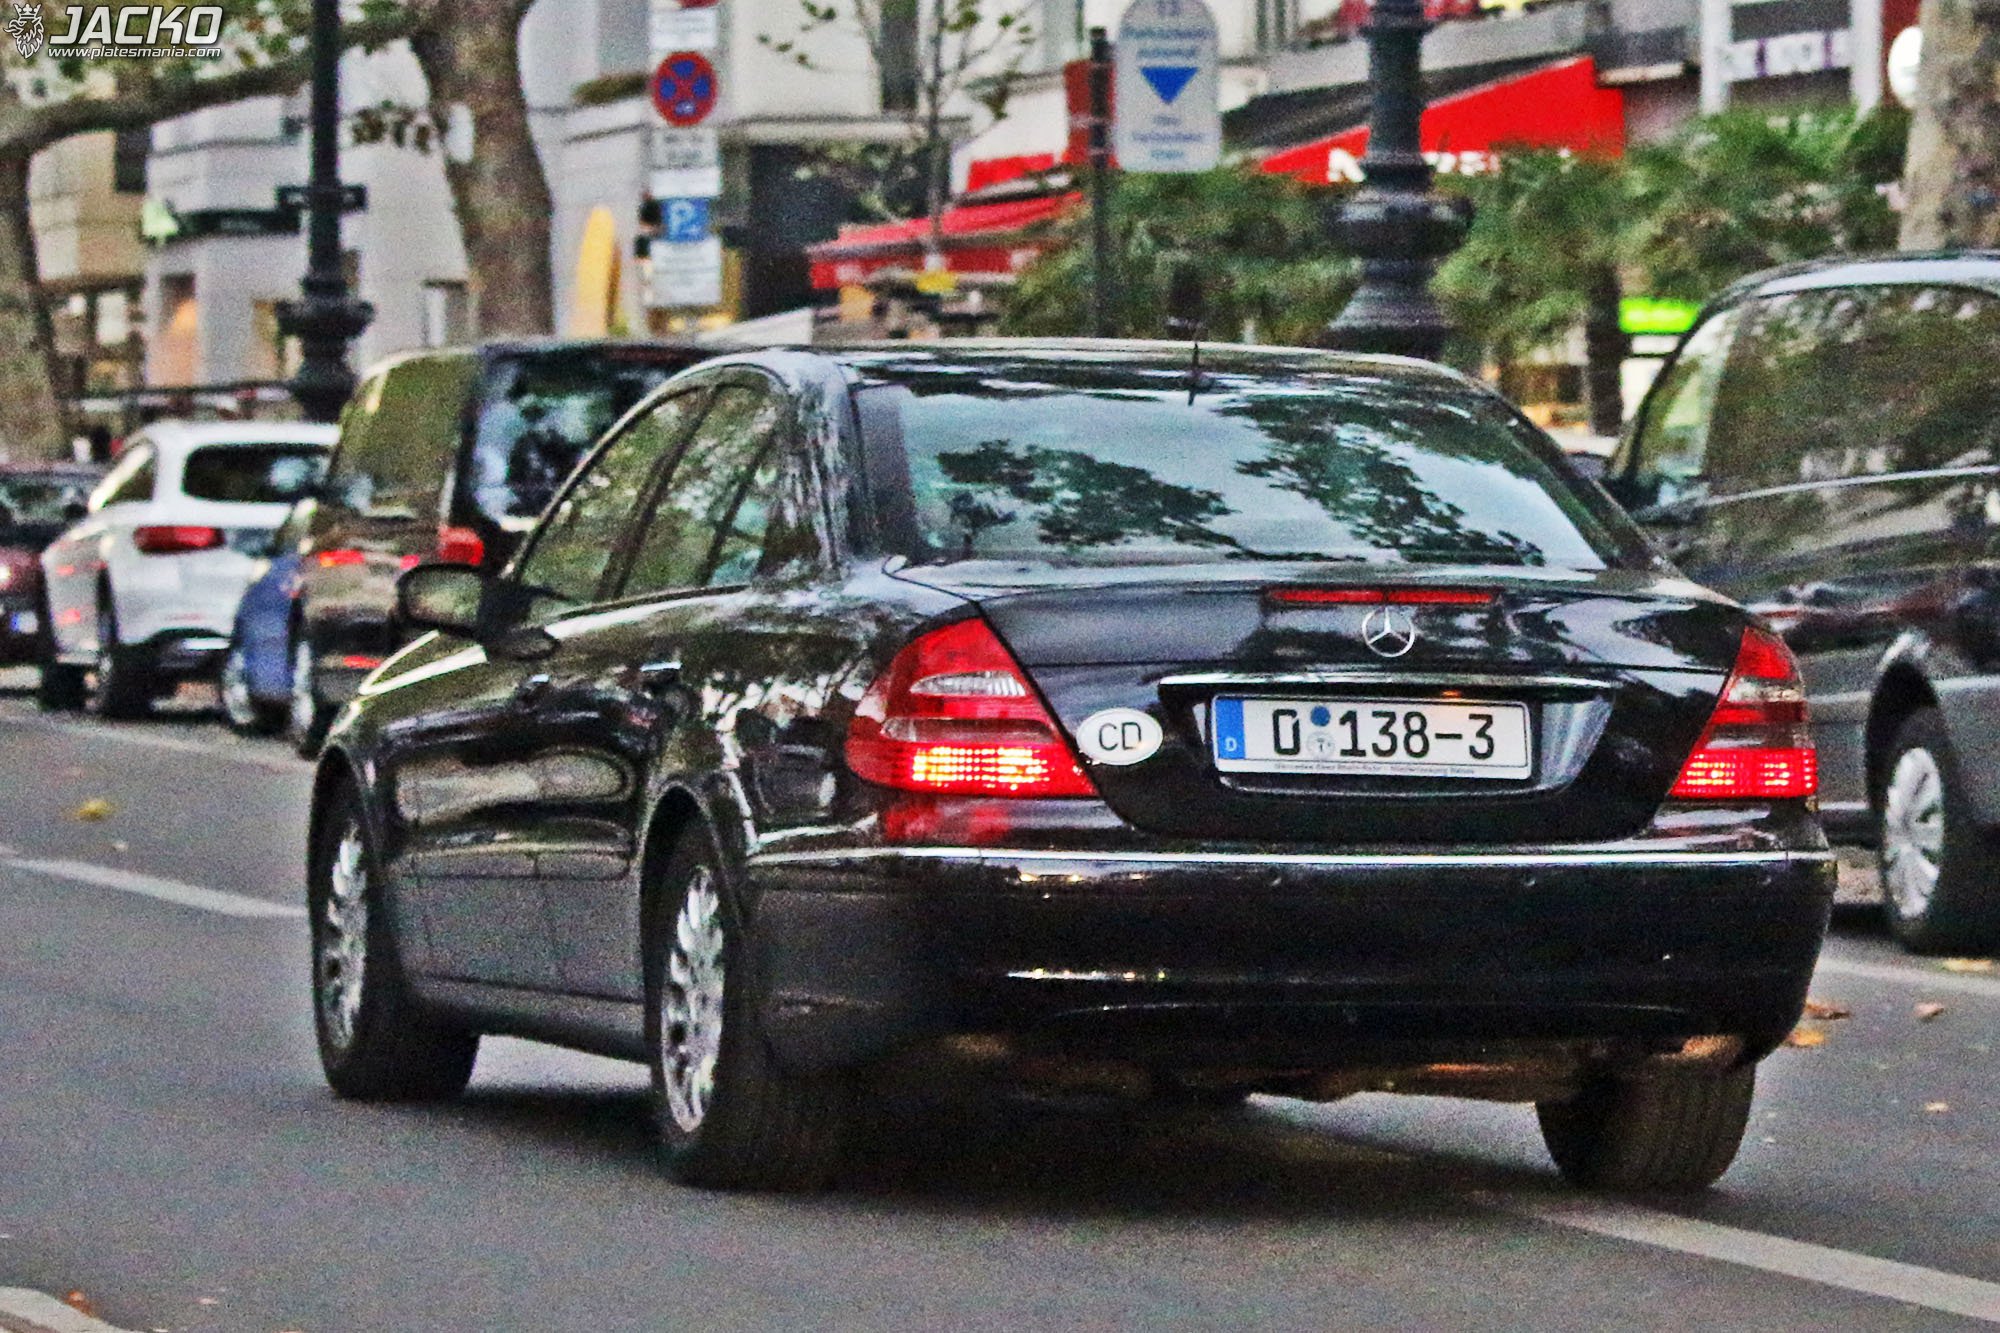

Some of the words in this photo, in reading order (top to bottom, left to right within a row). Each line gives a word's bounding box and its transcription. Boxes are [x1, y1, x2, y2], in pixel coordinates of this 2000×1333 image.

[669, 201, 696, 242] P
[1099, 722, 1141, 751] CD
[1225, 737, 1237, 751] D
[1339, 709, 1495, 760] 138-3
